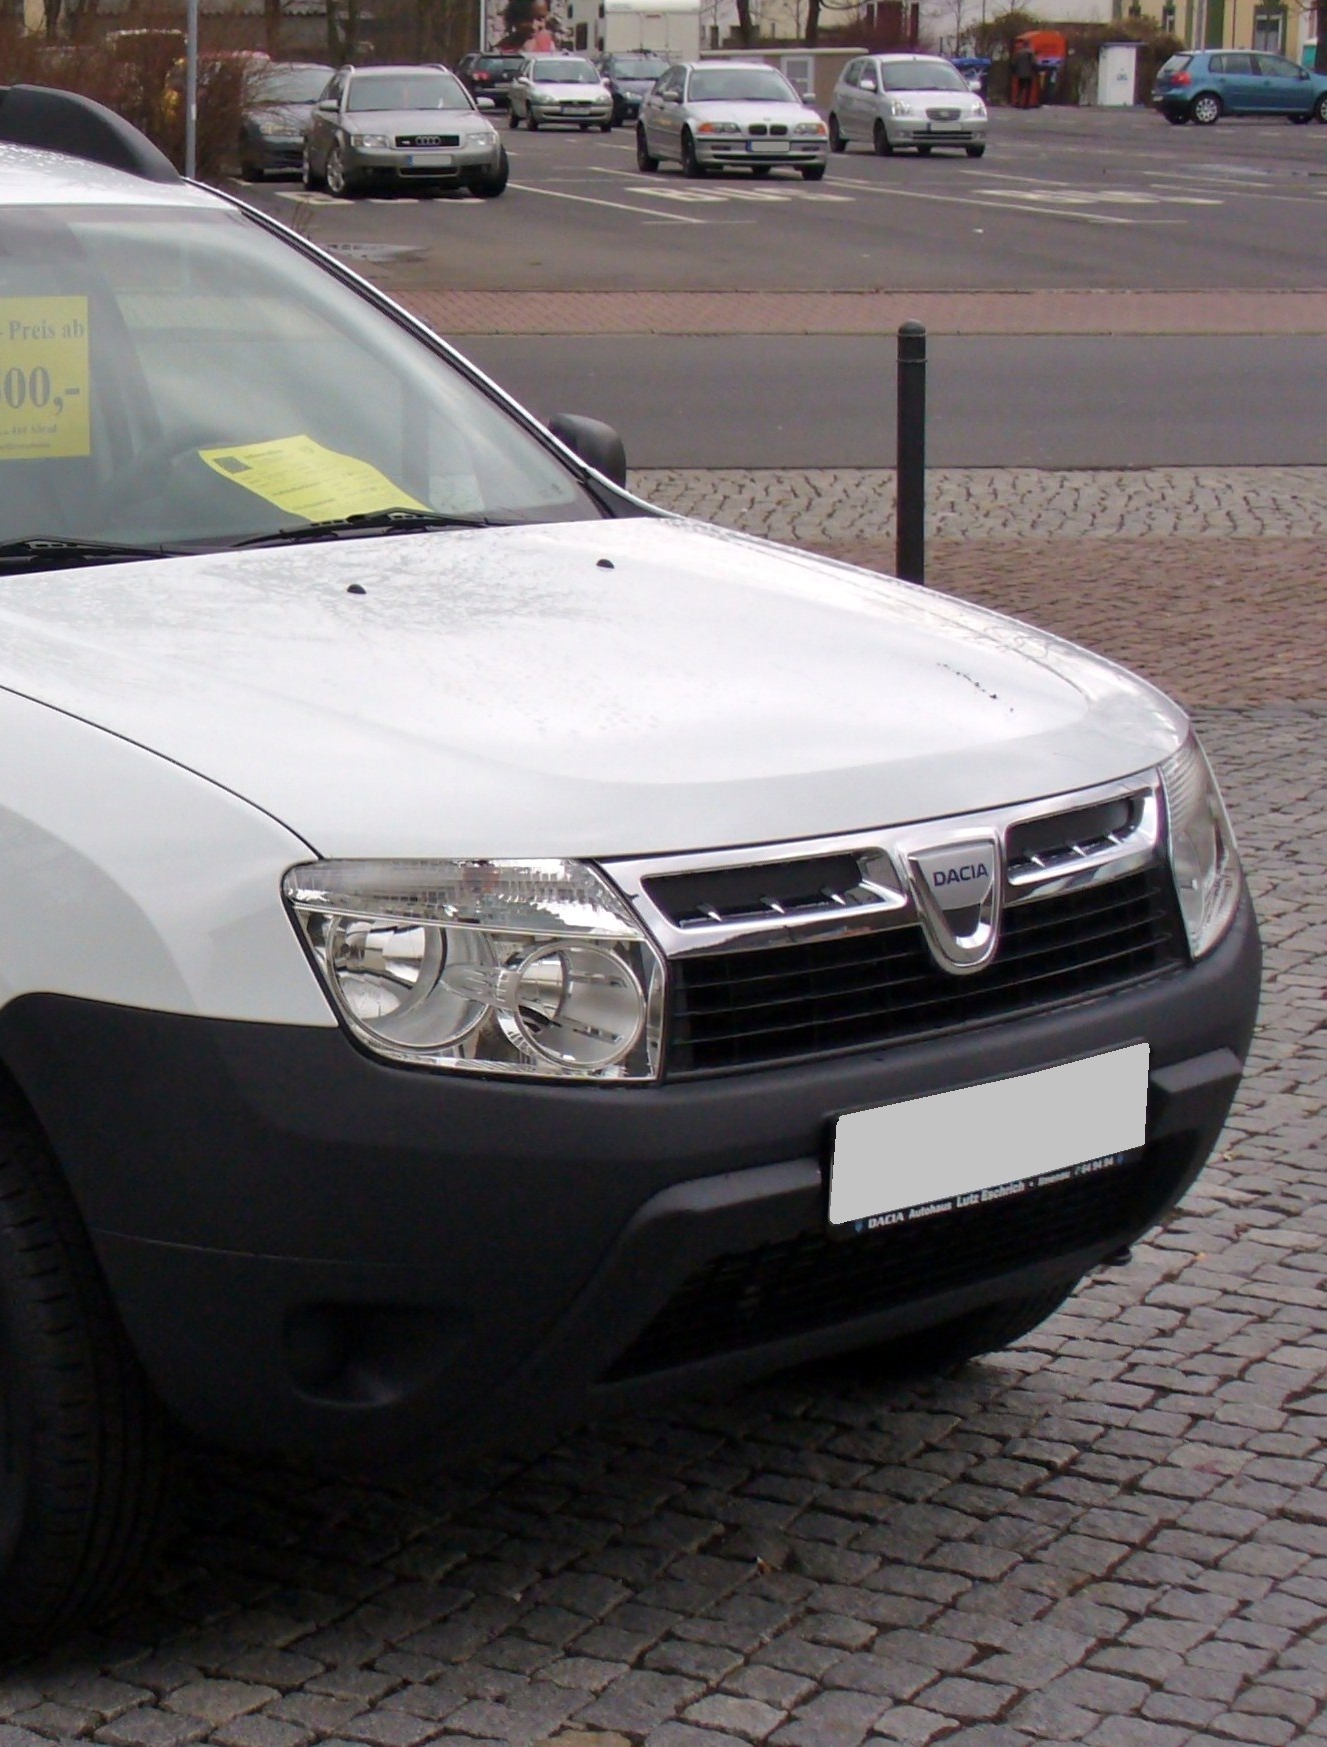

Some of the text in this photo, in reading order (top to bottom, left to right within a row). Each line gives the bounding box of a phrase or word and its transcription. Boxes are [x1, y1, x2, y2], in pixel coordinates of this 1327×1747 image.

[625, 187, 857, 202] BUS
[8, 320, 56, 341] Preis
[61, 318, 85, 339] ab
[933, 864, 988, 887] DACIA
[868, 1213, 904, 1229] DACIA
[908, 1201, 953, 1219] Autohaus
[956, 1195, 980, 1208] Lutz
[981, 1180, 1025, 1202] Eschrich
